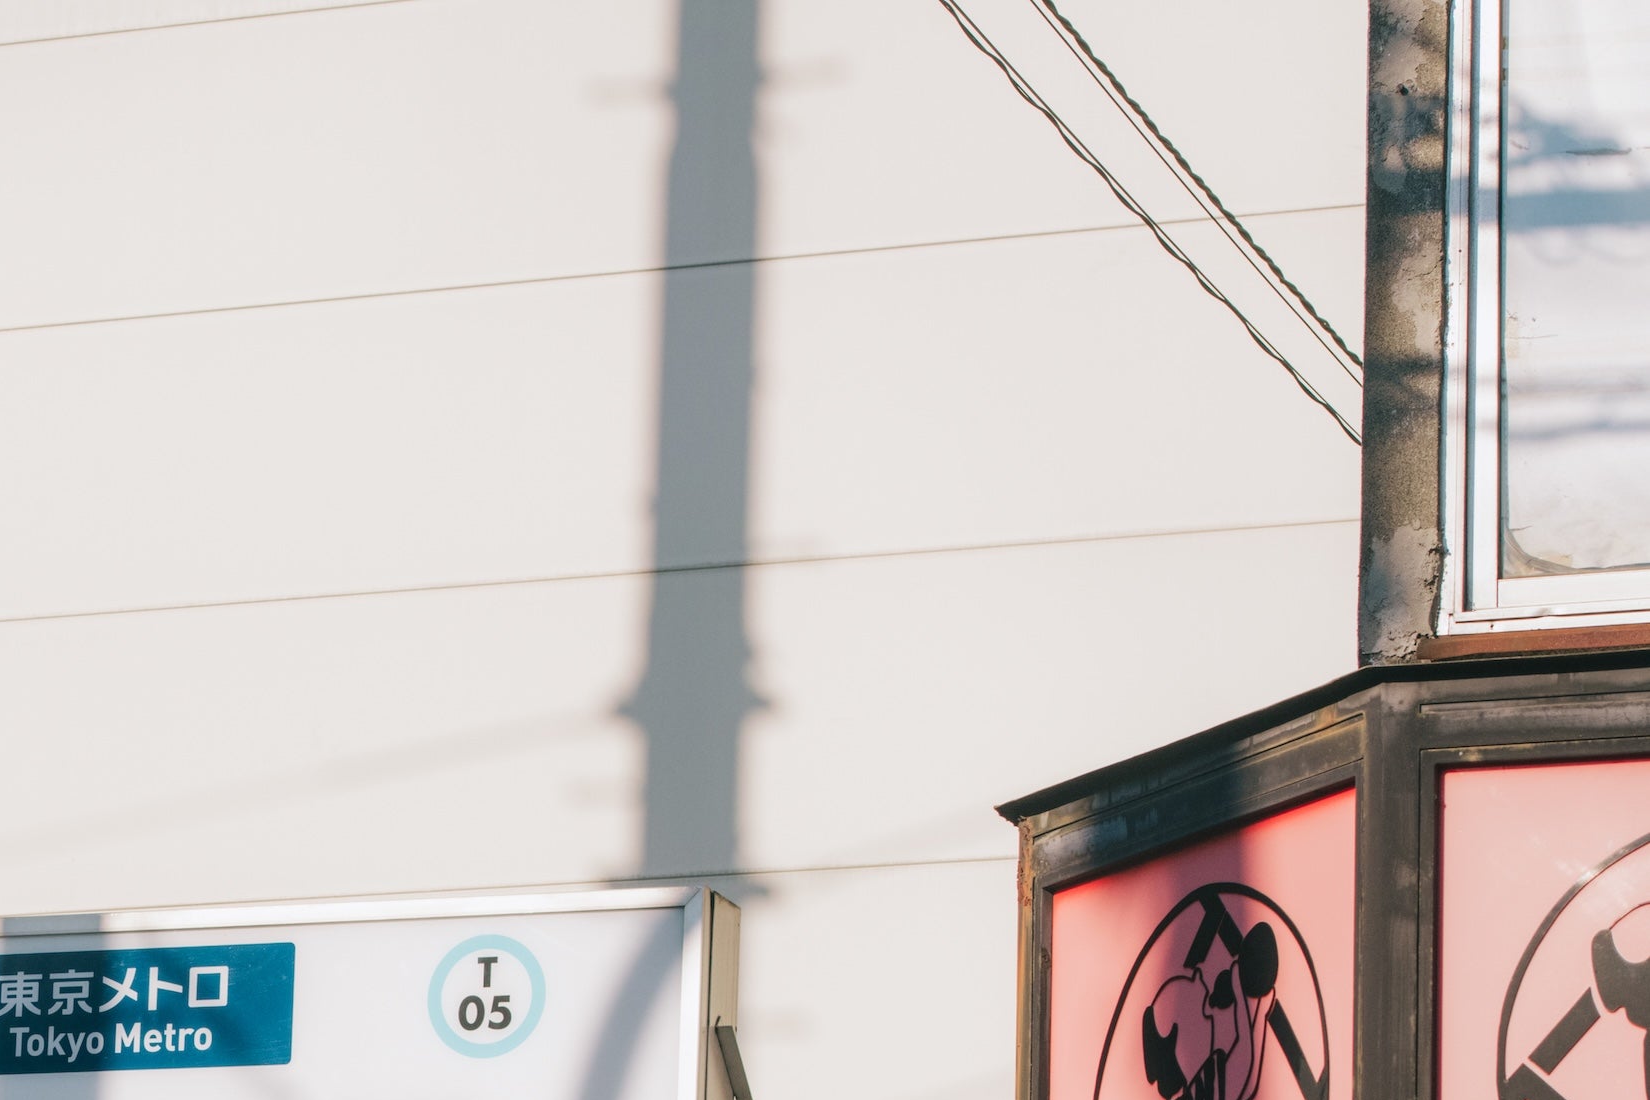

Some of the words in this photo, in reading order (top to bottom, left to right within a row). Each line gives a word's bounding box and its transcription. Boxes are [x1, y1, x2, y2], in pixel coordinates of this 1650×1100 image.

[477, 956, 498, 988] T
[458, 995, 512, 1031] 05
[9, 1025, 105, 1063] Tokyo
[114, 1022, 213, 1054] Metro
